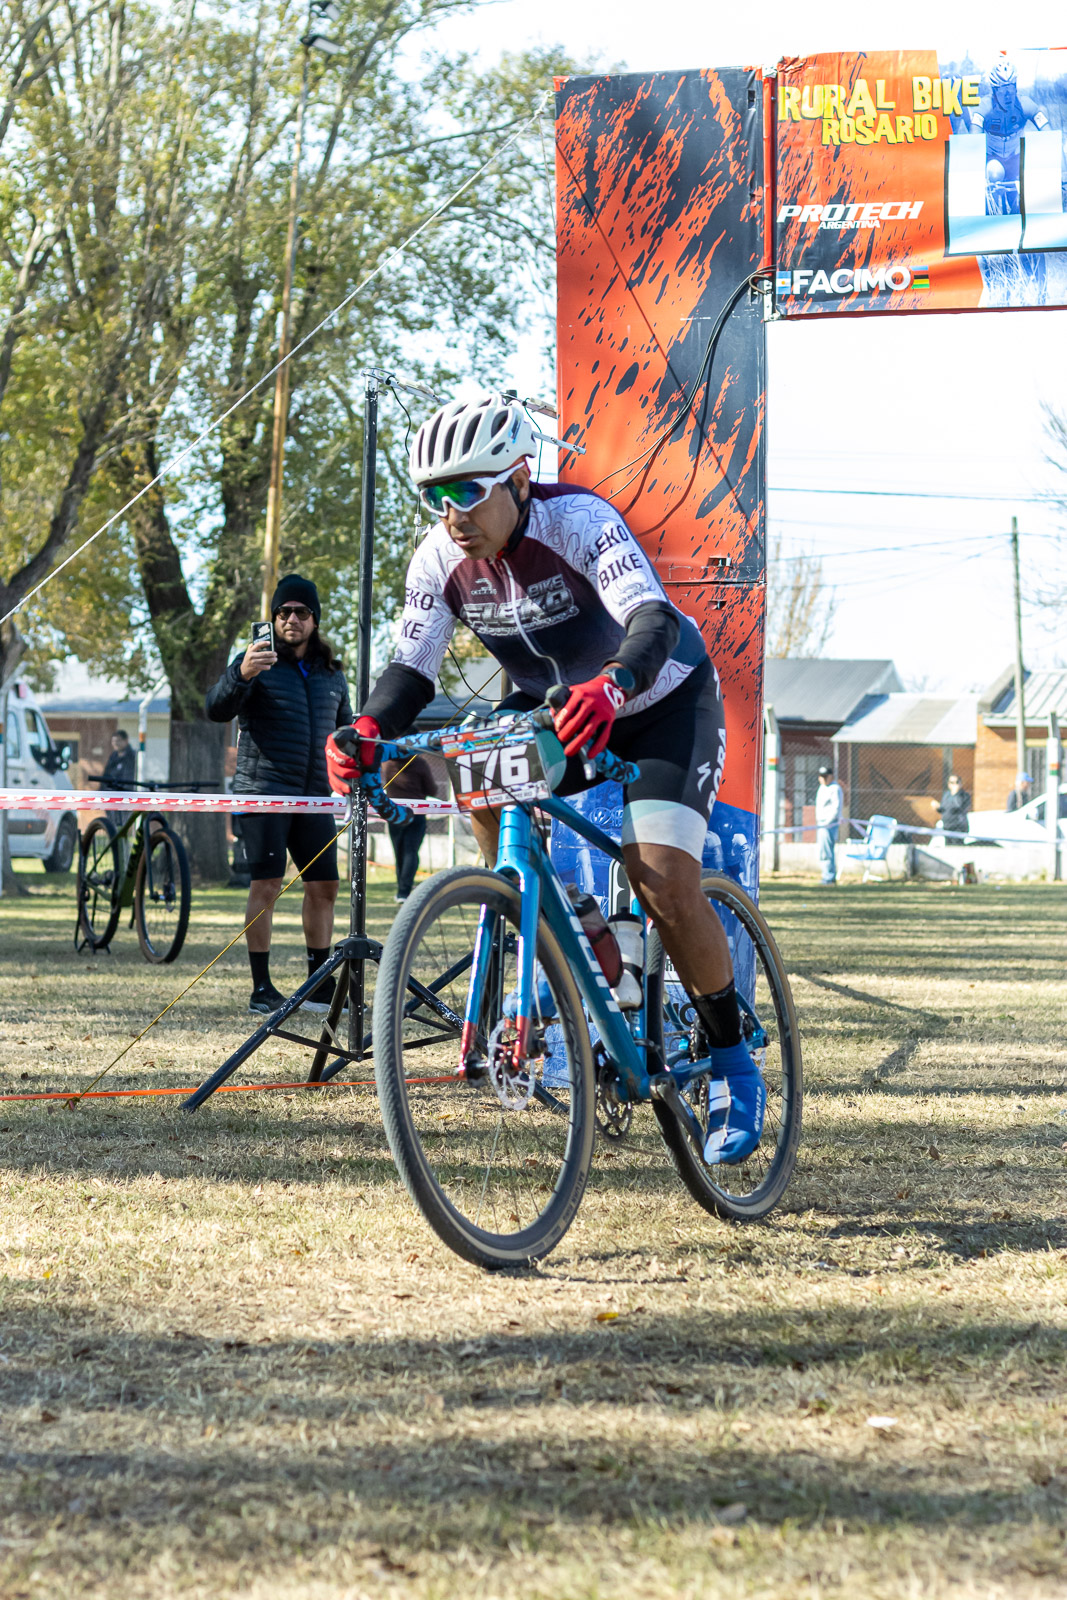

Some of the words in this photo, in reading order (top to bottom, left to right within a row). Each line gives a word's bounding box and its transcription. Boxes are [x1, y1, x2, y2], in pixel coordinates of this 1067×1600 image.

[777, 79, 896, 121] RURAL
[912, 75, 982, 117] BIKE
[822, 114, 939, 145] ROSARIO
[776, 201, 924, 222] PROTECH
[818, 219, 881, 230] ARGENTINA
[792, 265, 911, 295] FACIMO
[528, 574, 564, 598] BIKE
[598, 552, 644, 591] BIKE
[455, 745, 528, 793] 176
